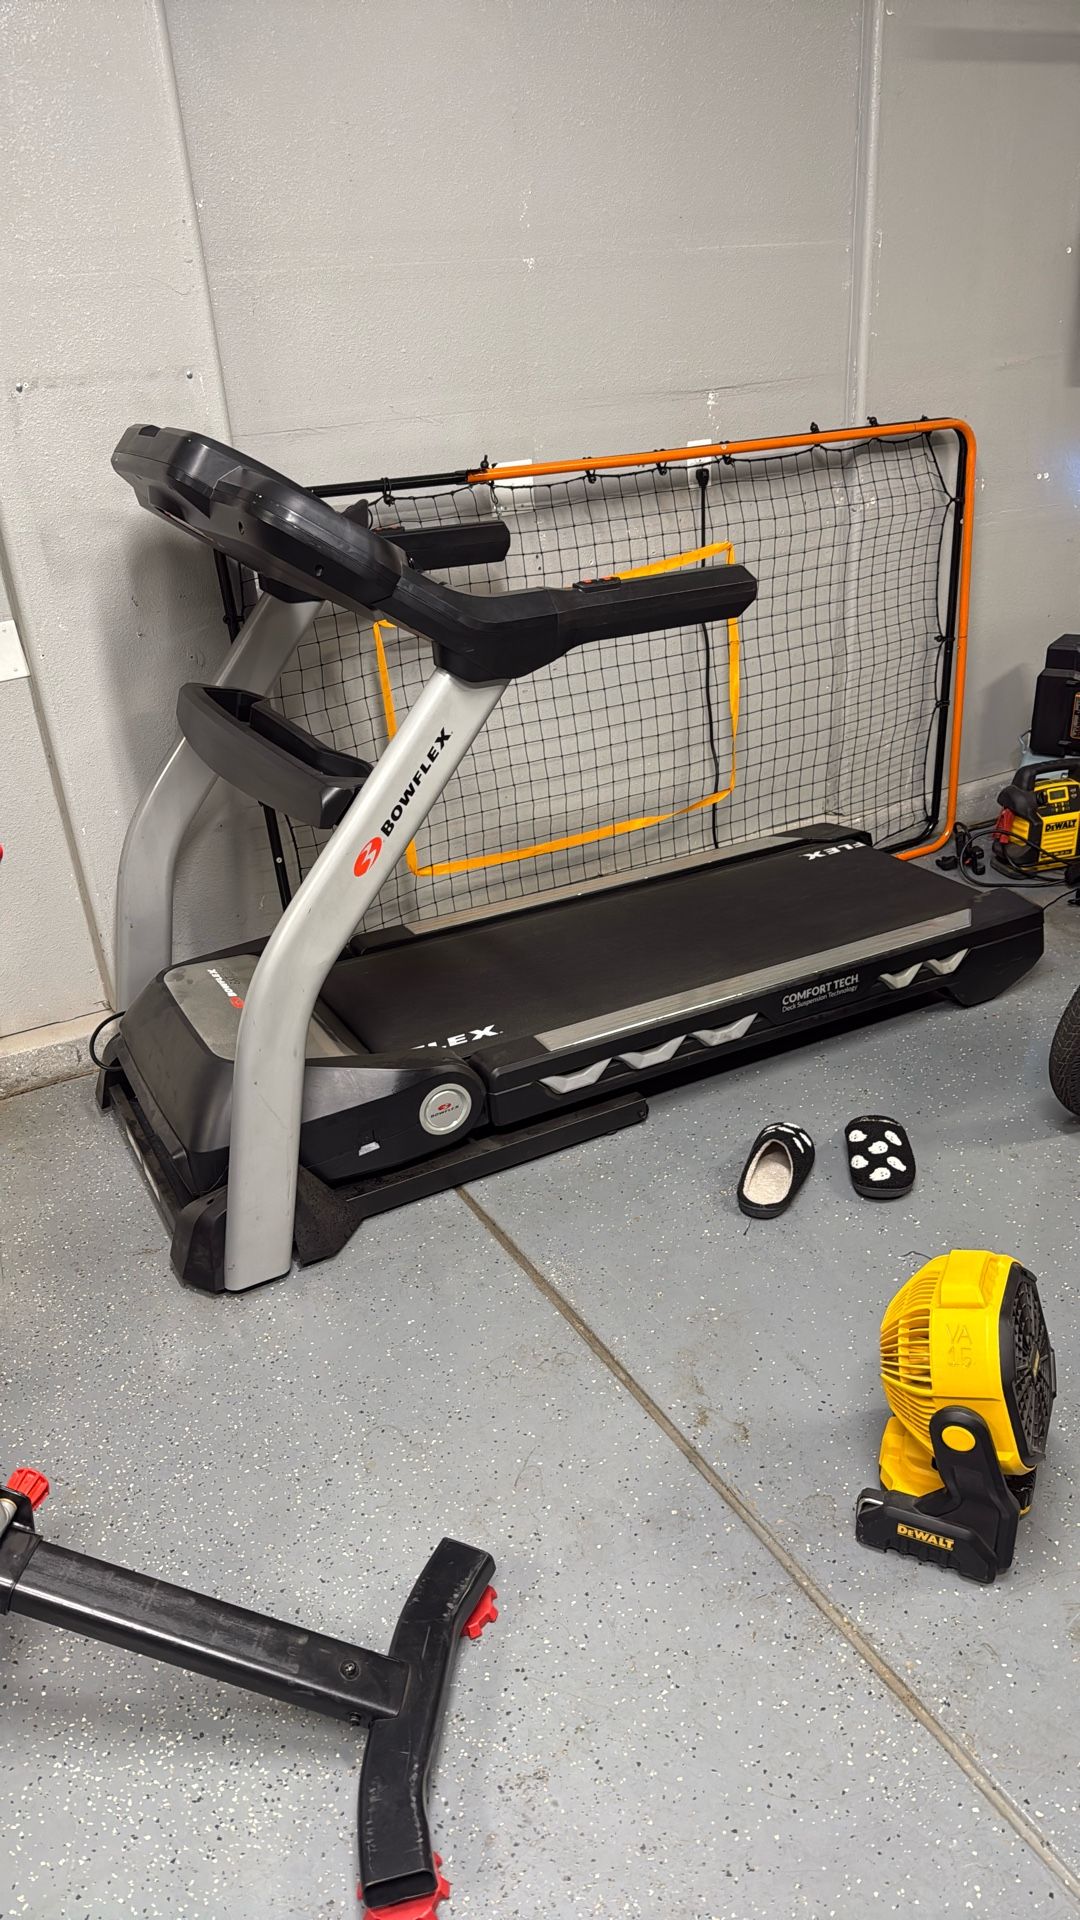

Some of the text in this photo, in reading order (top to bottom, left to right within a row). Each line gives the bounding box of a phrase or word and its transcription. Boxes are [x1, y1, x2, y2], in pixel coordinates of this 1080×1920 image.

[380, 727, 452, 837] BOWFLEX
[782, 974, 859, 1005] COMFORT TECH
[782, 1004, 797, 1013] Deck
[828, 985, 858, 999] Technology
[945, 1322, 973, 1344] VA
